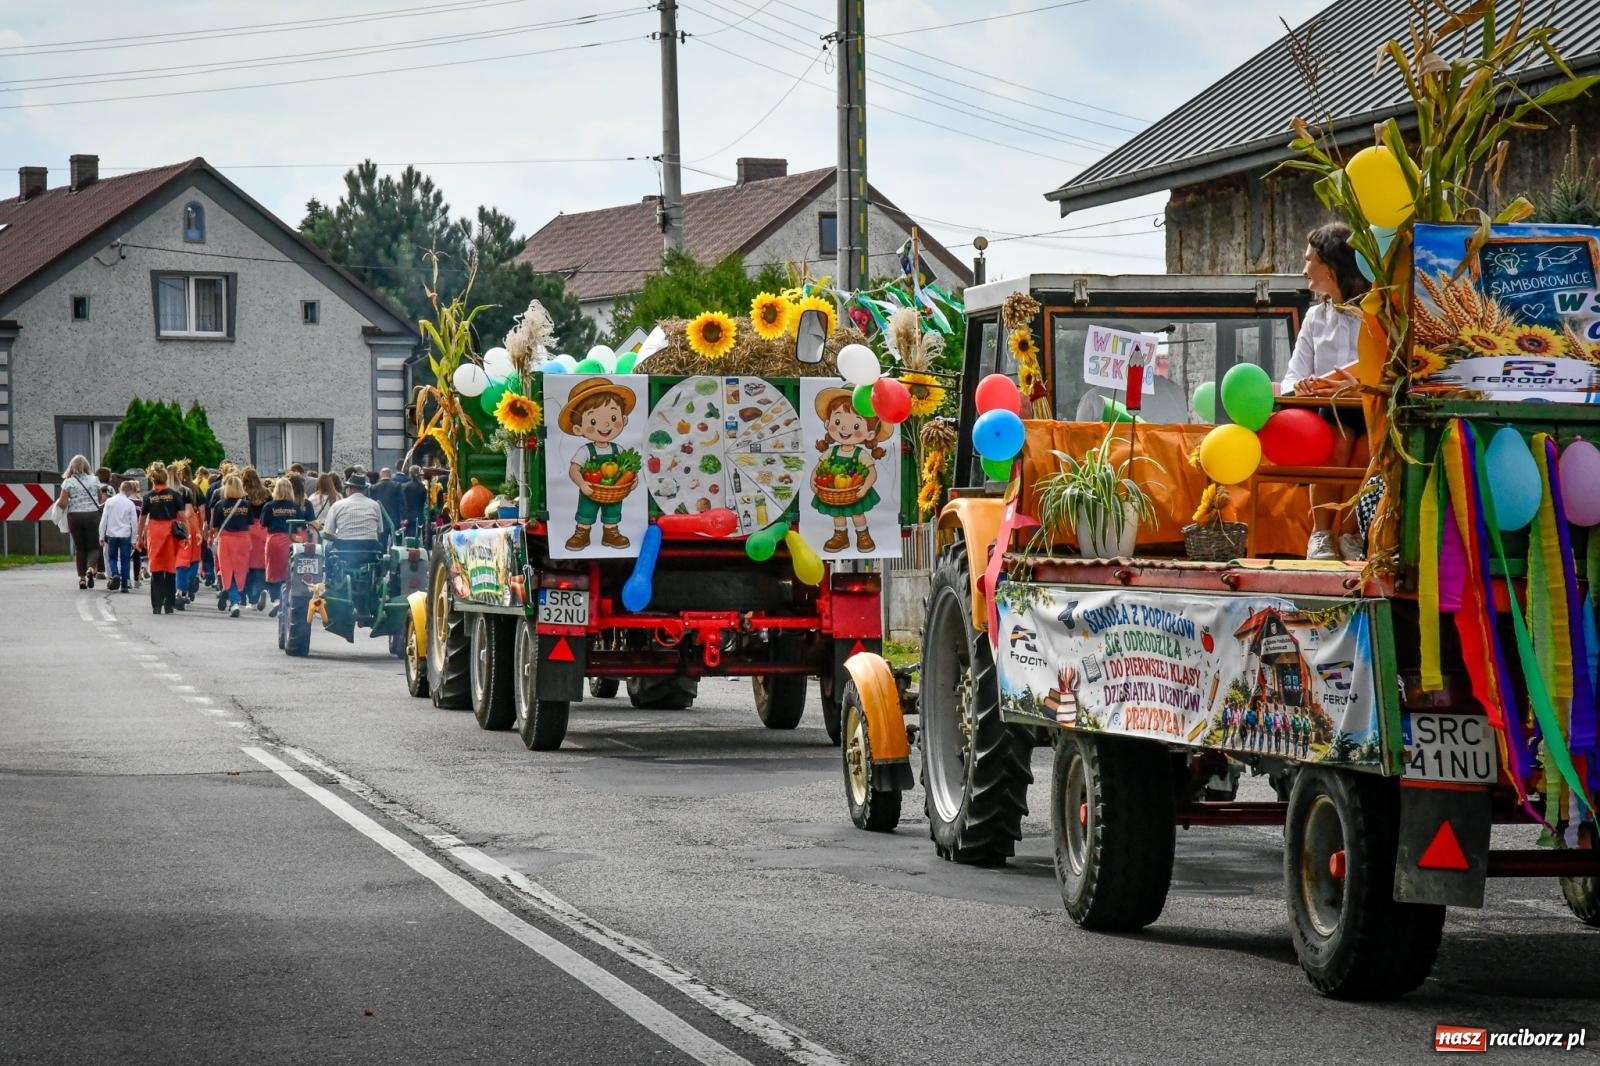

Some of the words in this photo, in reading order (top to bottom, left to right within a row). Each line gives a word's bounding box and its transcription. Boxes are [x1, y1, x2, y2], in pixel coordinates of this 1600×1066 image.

[1491, 271, 1592, 295] SAMBOROWICE
[1472, 376, 1583, 385] FEROCITY
[549, 591, 582, 607] SRC
[543, 608, 586, 624] 32NU
[1083, 603, 1130, 634] SZKOŁA
[1141, 605, 1195, 640] POPIOŁÓW
[1104, 632, 1123, 657] SIĘ
[1123, 630, 1182, 660] ODRODZIŁA
[1109, 660, 1124, 679] DO
[1125, 657, 1169, 680] PIERWSZEJ
[1170, 663, 1201, 689] KLASY
[1103, 681, 1156, 706] DZIESIĄTKA
[1158, 683, 1201, 712] UCZNIÓW
[1125, 706, 1186, 737] PRZYBYŁA!
[1416, 716, 1481, 746] SRC
[1410, 749, 1491, 779] 41NU
